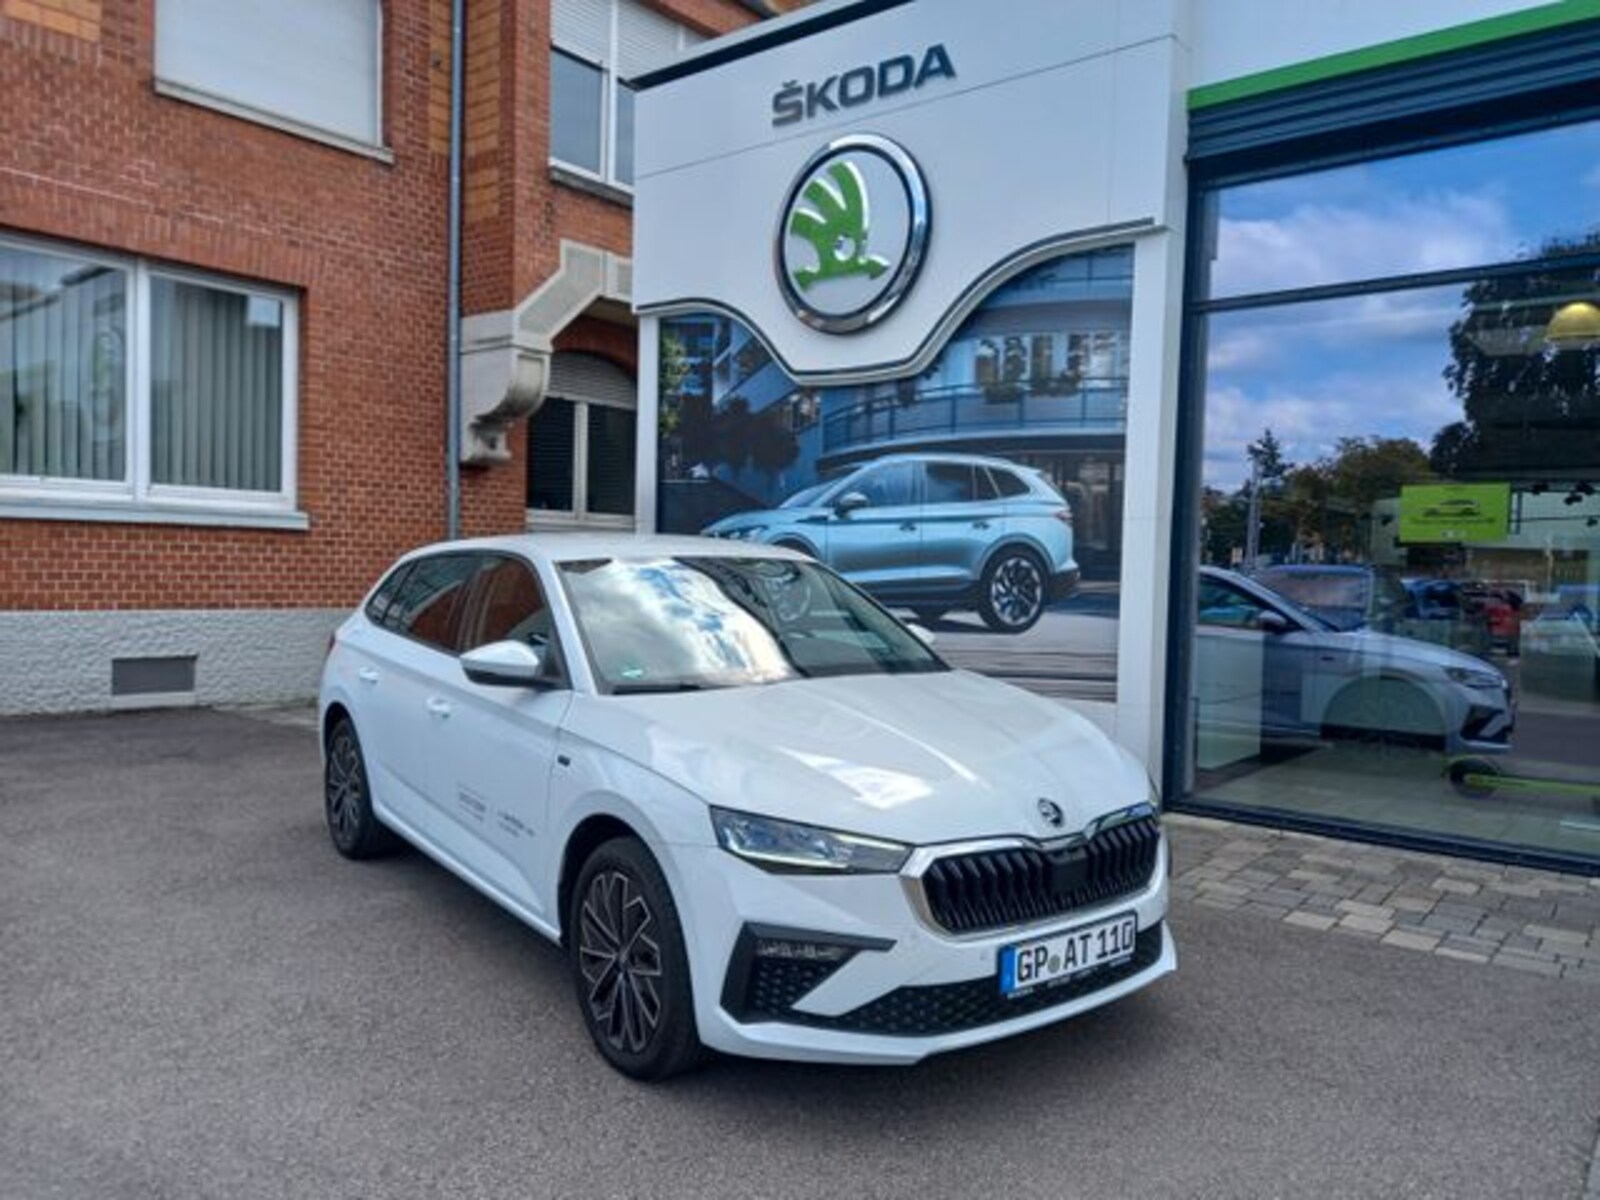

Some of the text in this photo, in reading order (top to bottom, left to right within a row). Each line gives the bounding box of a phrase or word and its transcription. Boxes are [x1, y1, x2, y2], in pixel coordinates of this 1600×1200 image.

[771, 43, 956, 127] ŠKODA
[1018, 945, 1048, 981] GP
[1063, 934, 1092, 969] AT
[1096, 921, 1133, 959] 110
